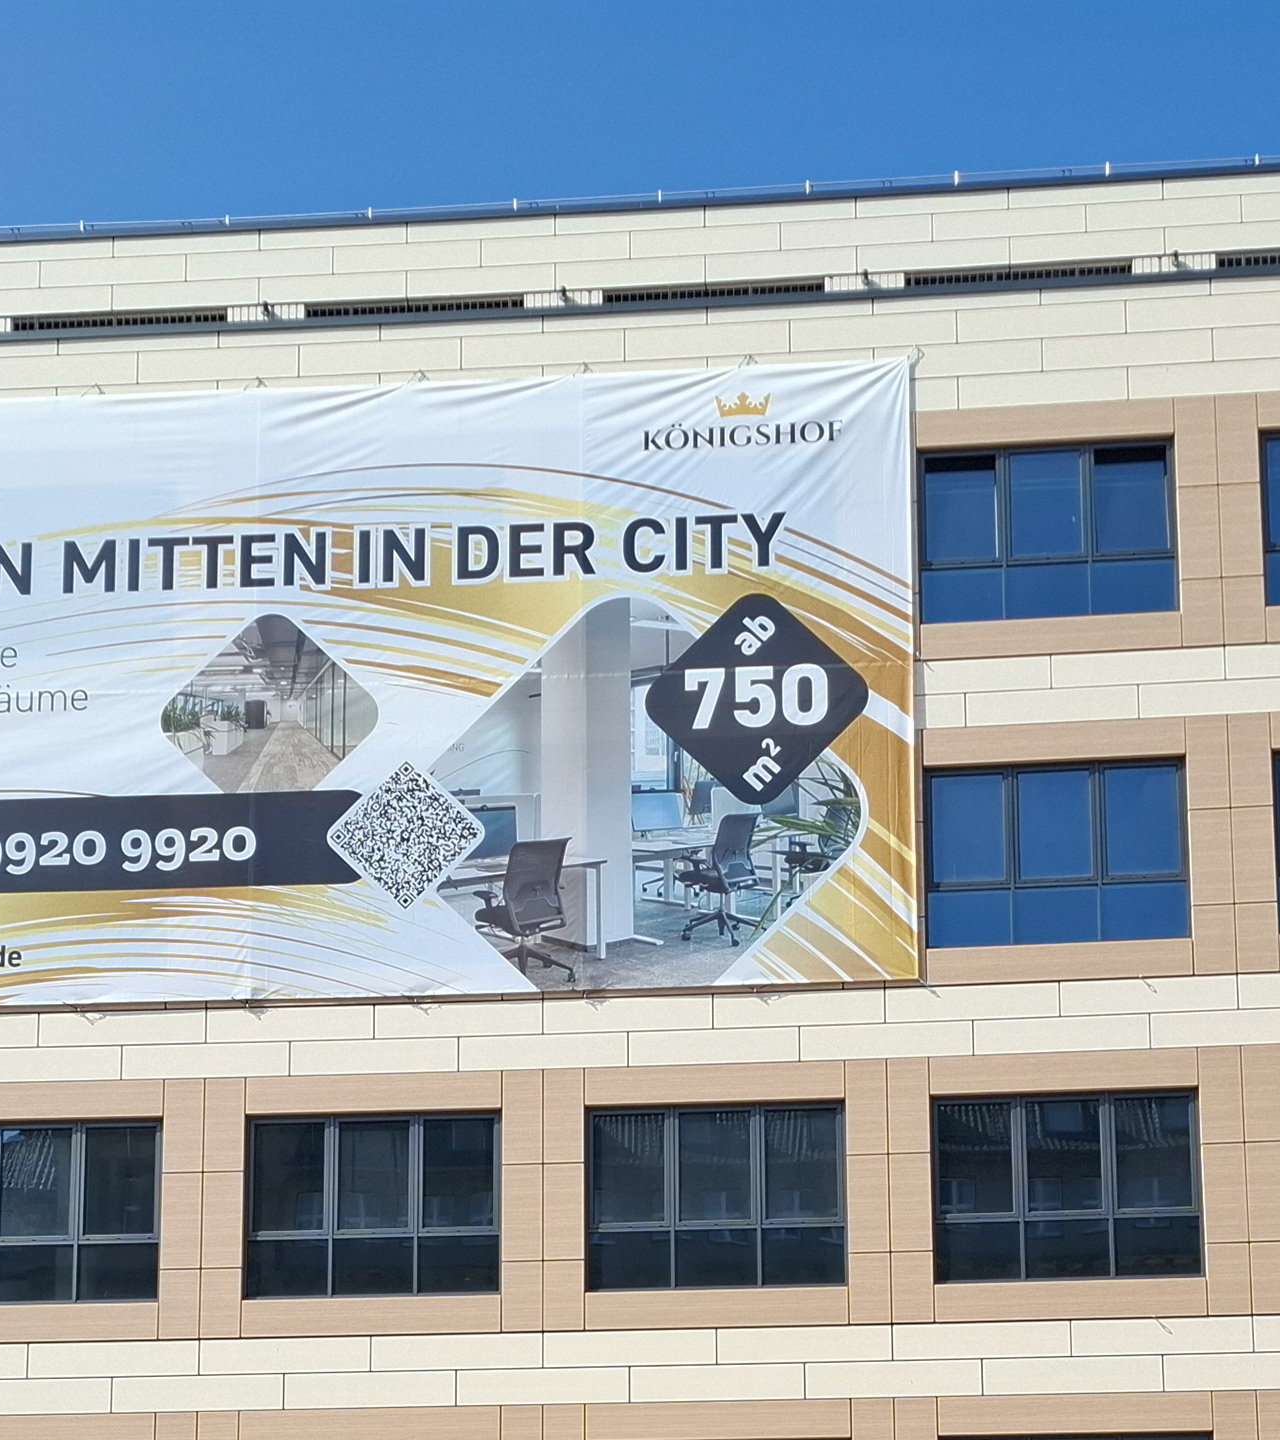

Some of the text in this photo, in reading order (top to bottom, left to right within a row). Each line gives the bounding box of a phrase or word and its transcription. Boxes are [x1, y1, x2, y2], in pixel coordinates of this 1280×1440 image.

[643, 420, 843, 451] KÖNIGSHOF
[61, 529, 327, 595] MITTEN
[358, 525, 425, 584] IN
[455, 521, 596, 582] DER
[622, 511, 787, 573] CITY
[734, 615, 776, 656] ab
[684, 663, 828, 730] 750
[120, 825, 257, 873] 9920
